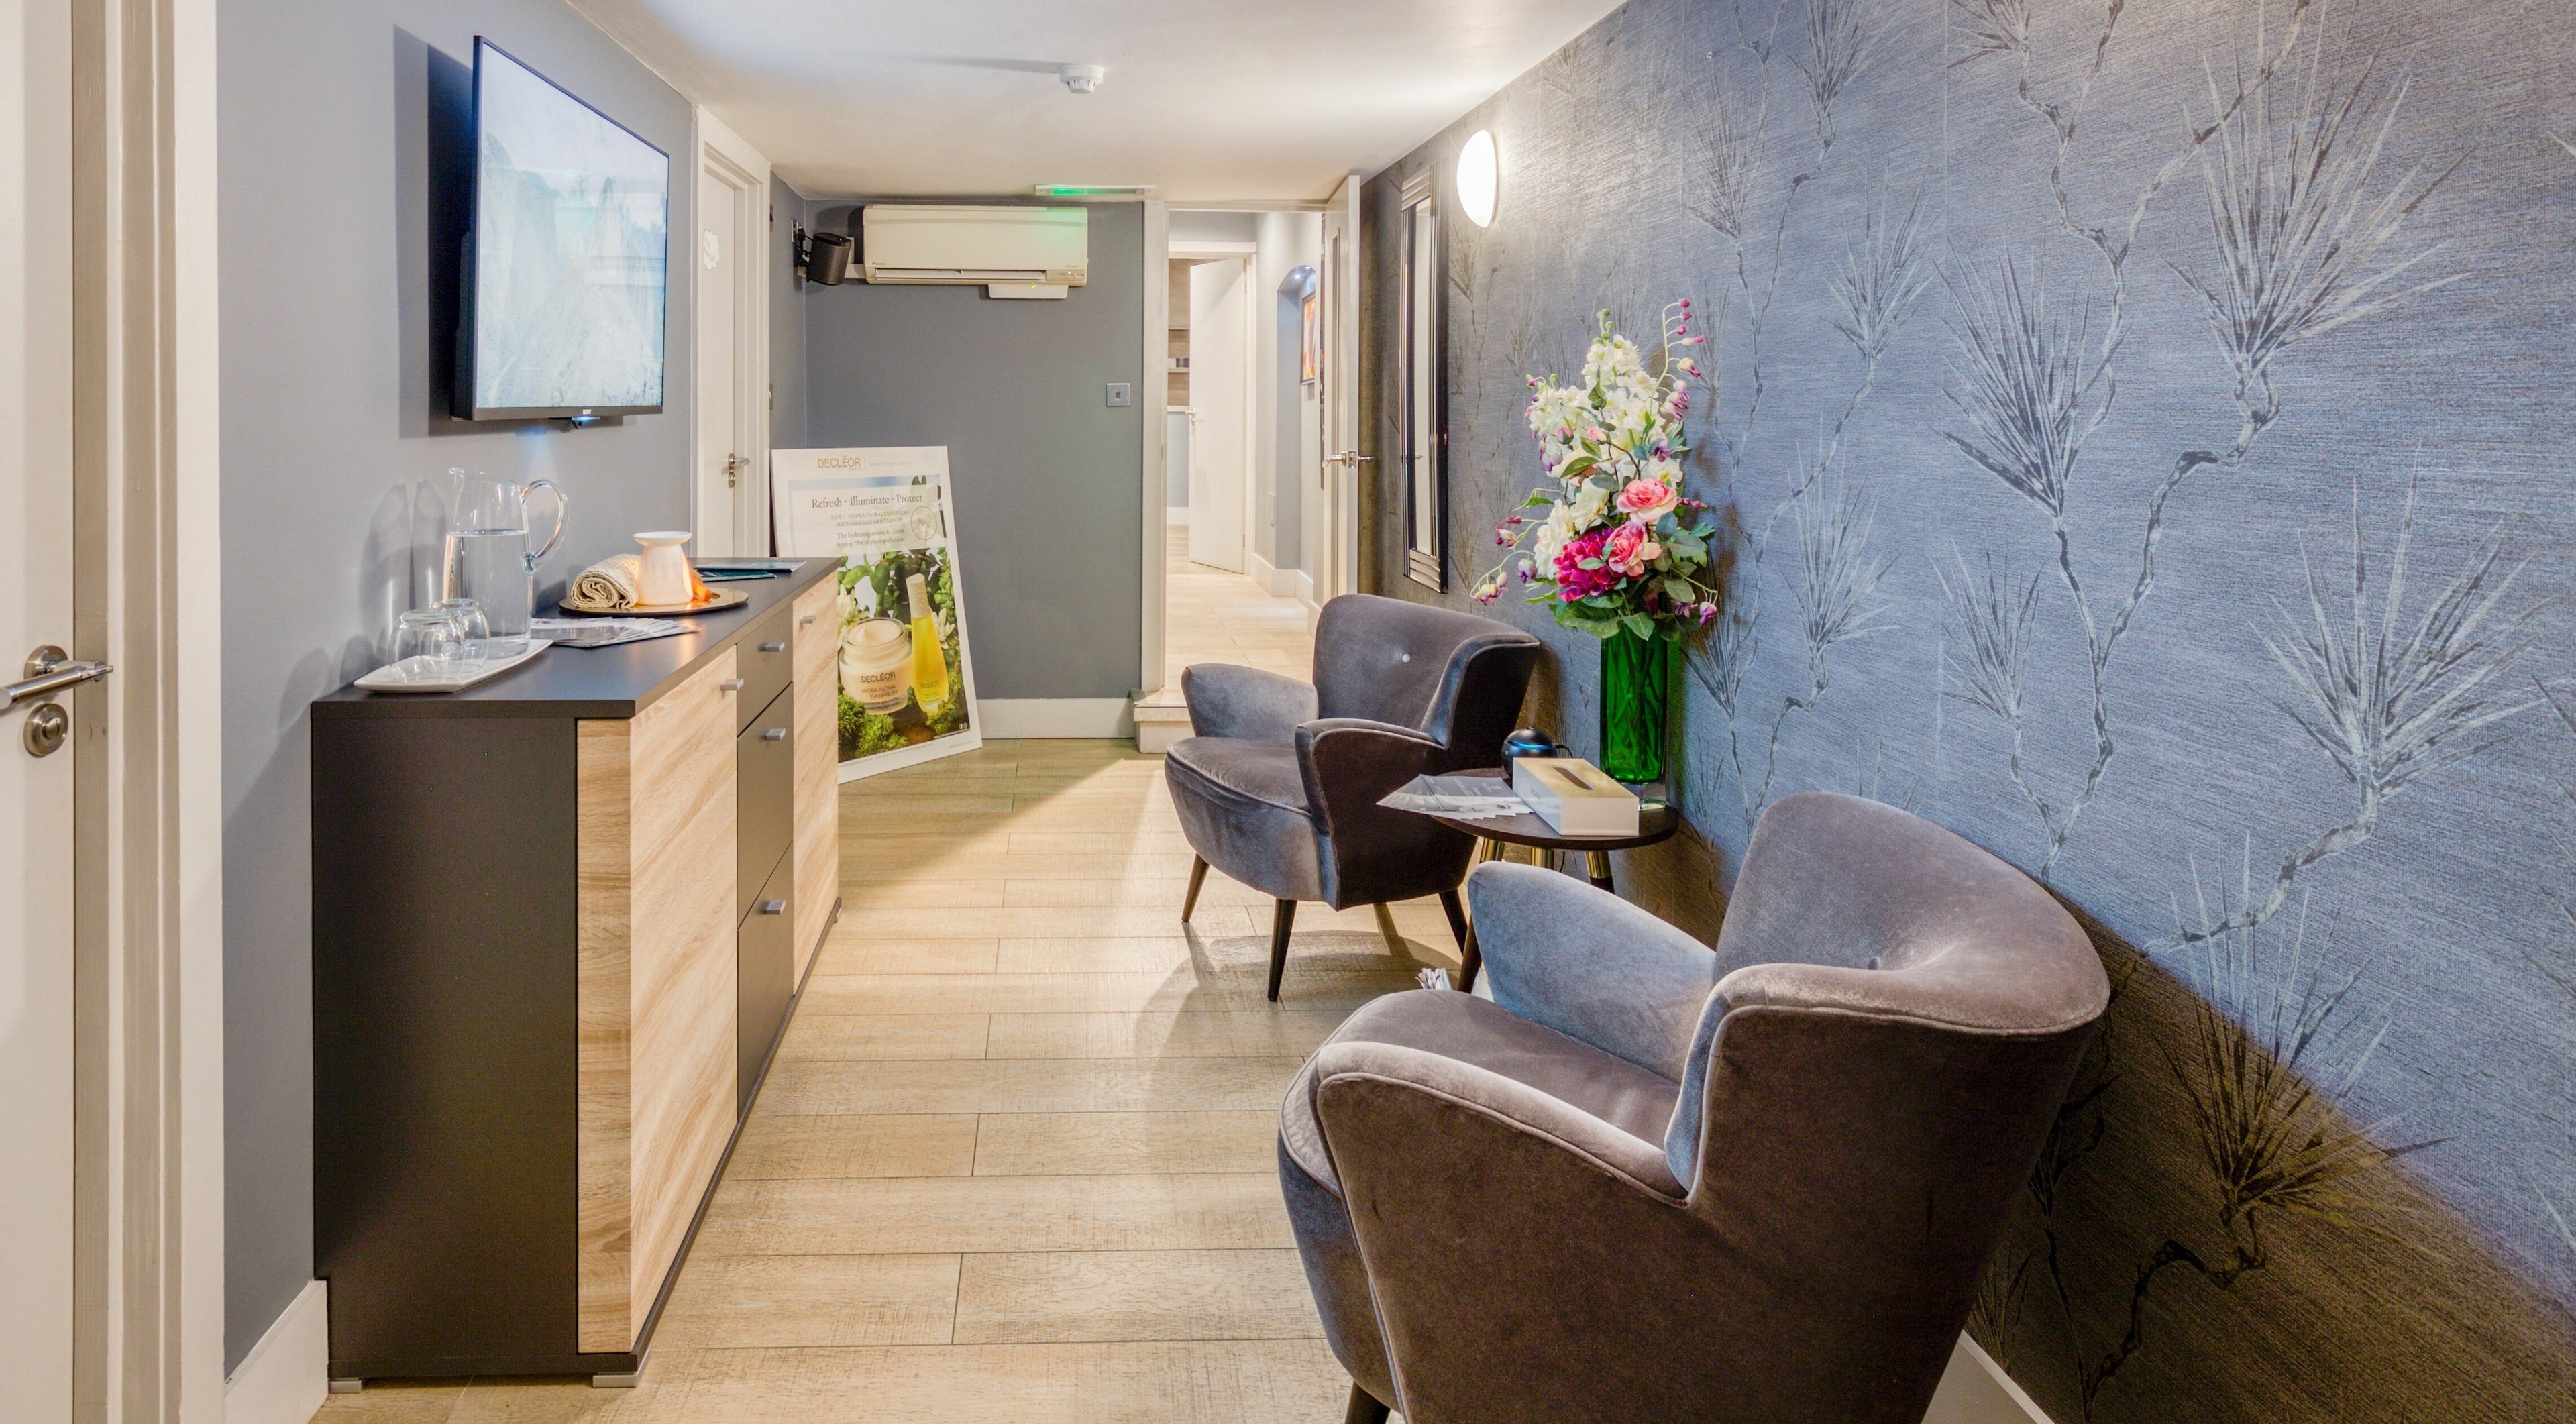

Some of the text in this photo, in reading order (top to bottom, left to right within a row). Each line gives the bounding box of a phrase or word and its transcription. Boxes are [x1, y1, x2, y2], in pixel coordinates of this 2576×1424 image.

[817, 456, 861, 468] DECLÉOR
[812, 494, 922, 508] Refresh Illuminate Protect
[847, 530, 871, 539] hydrating
[861, 671, 896, 683] DECLÉOR
